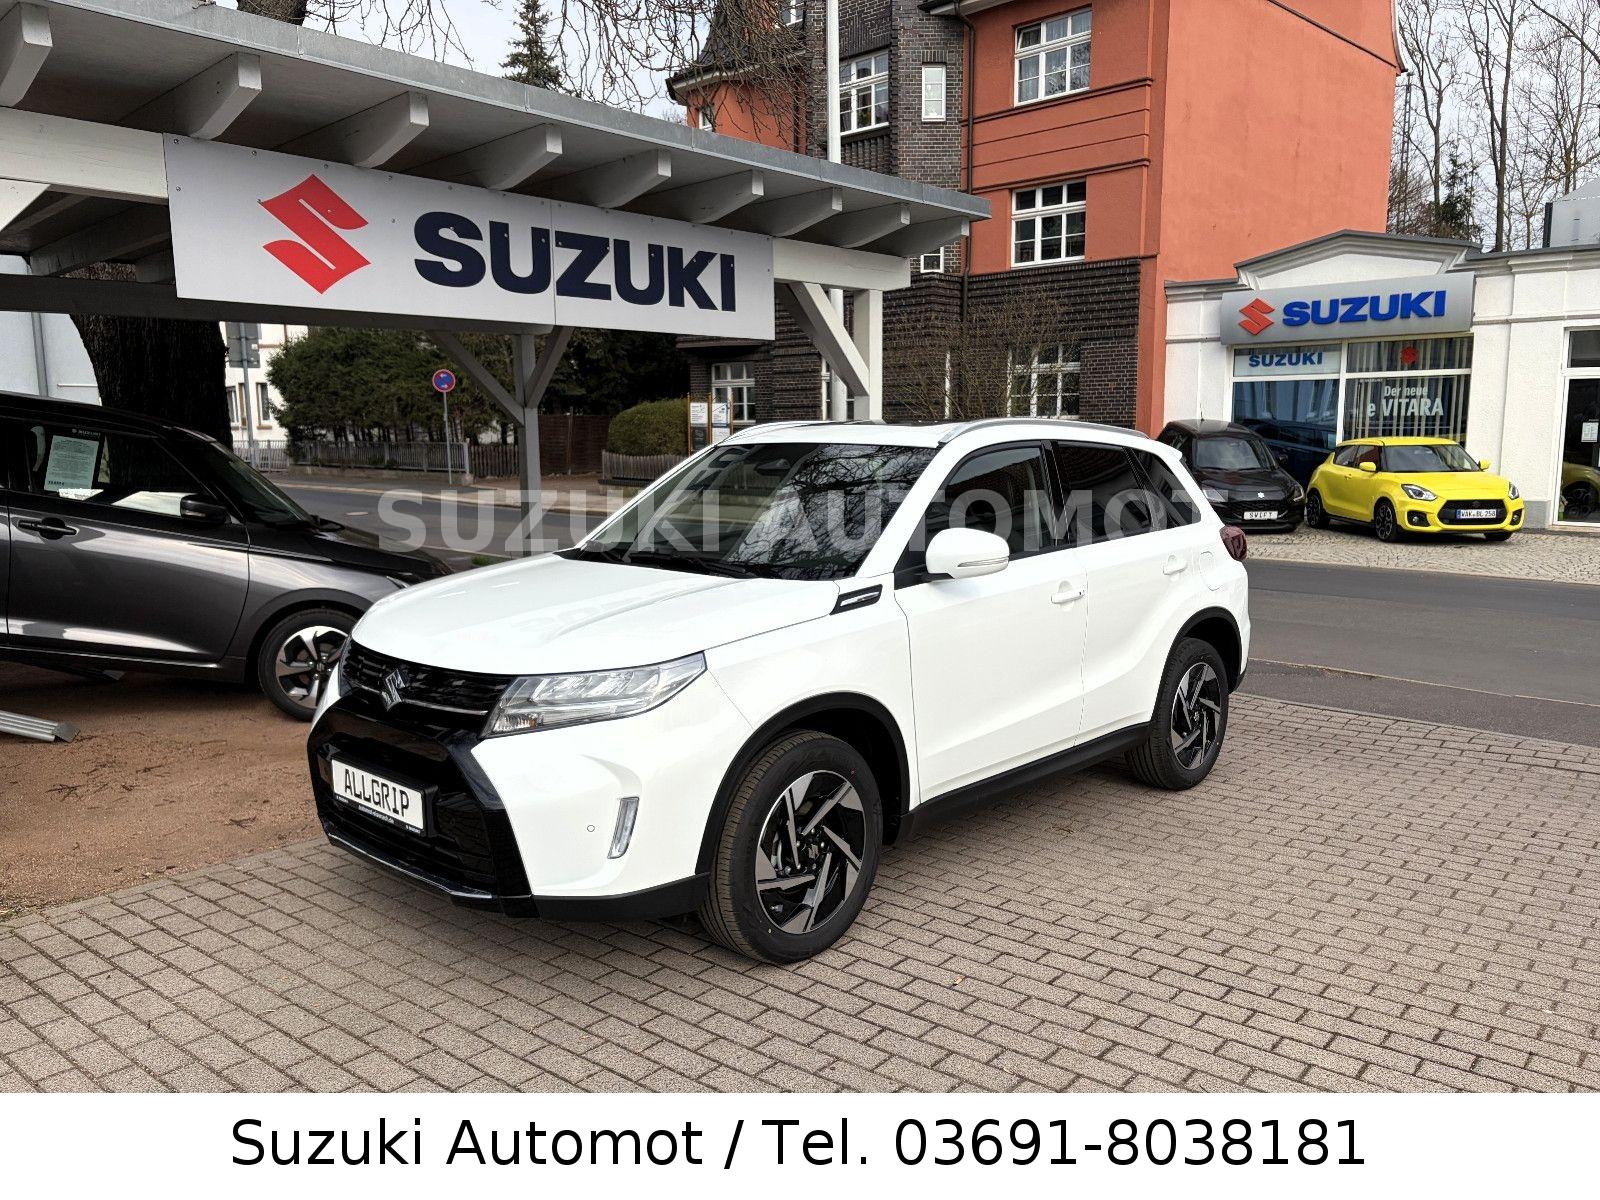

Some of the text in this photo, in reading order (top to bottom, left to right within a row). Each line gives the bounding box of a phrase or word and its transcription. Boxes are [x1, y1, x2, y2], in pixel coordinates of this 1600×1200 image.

[413, 211, 737, 313] SUZUKI
[1283, 290, 1447, 327] SUZUKI
[1249, 352, 1323, 367] SUZUKI
[1384, 385, 1429, 397] Der neue
[1367, 397, 1444, 417] e VITARA
[344, 768, 410, 817] ALLGRIP
